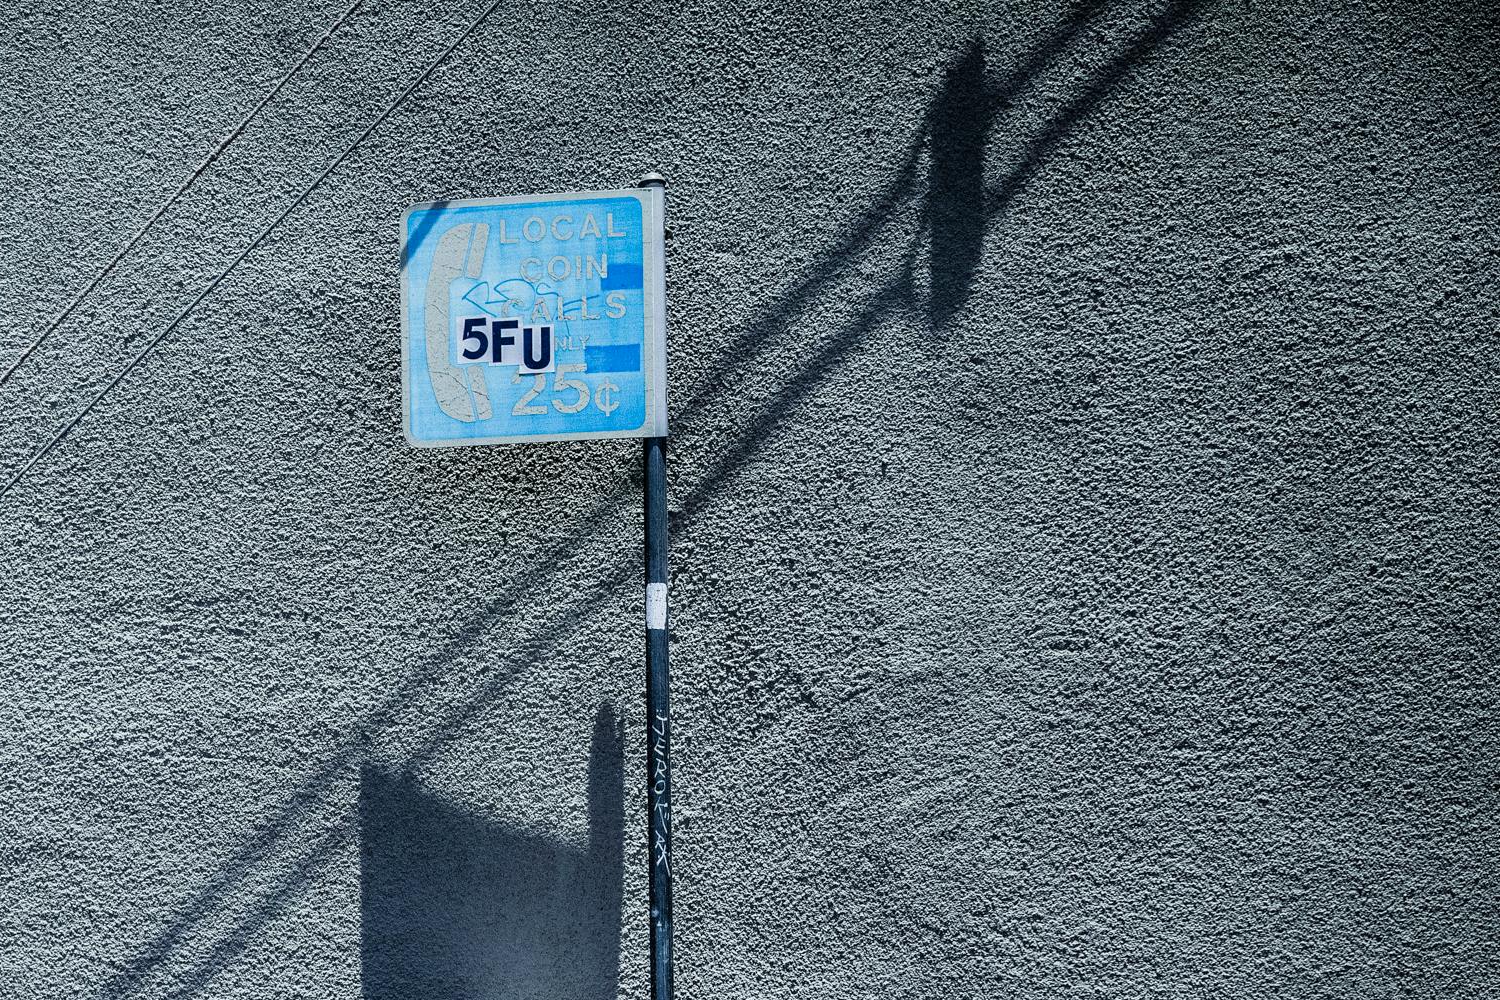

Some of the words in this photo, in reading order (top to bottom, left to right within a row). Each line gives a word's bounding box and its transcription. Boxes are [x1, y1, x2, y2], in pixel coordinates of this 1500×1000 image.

[499, 212, 627, 245] LOCAL
[519, 253, 608, 284] COIN
[501, 291, 627, 322] CALLS
[462, 317, 551, 370] 5FU
[553, 335, 589, 352] NLY
